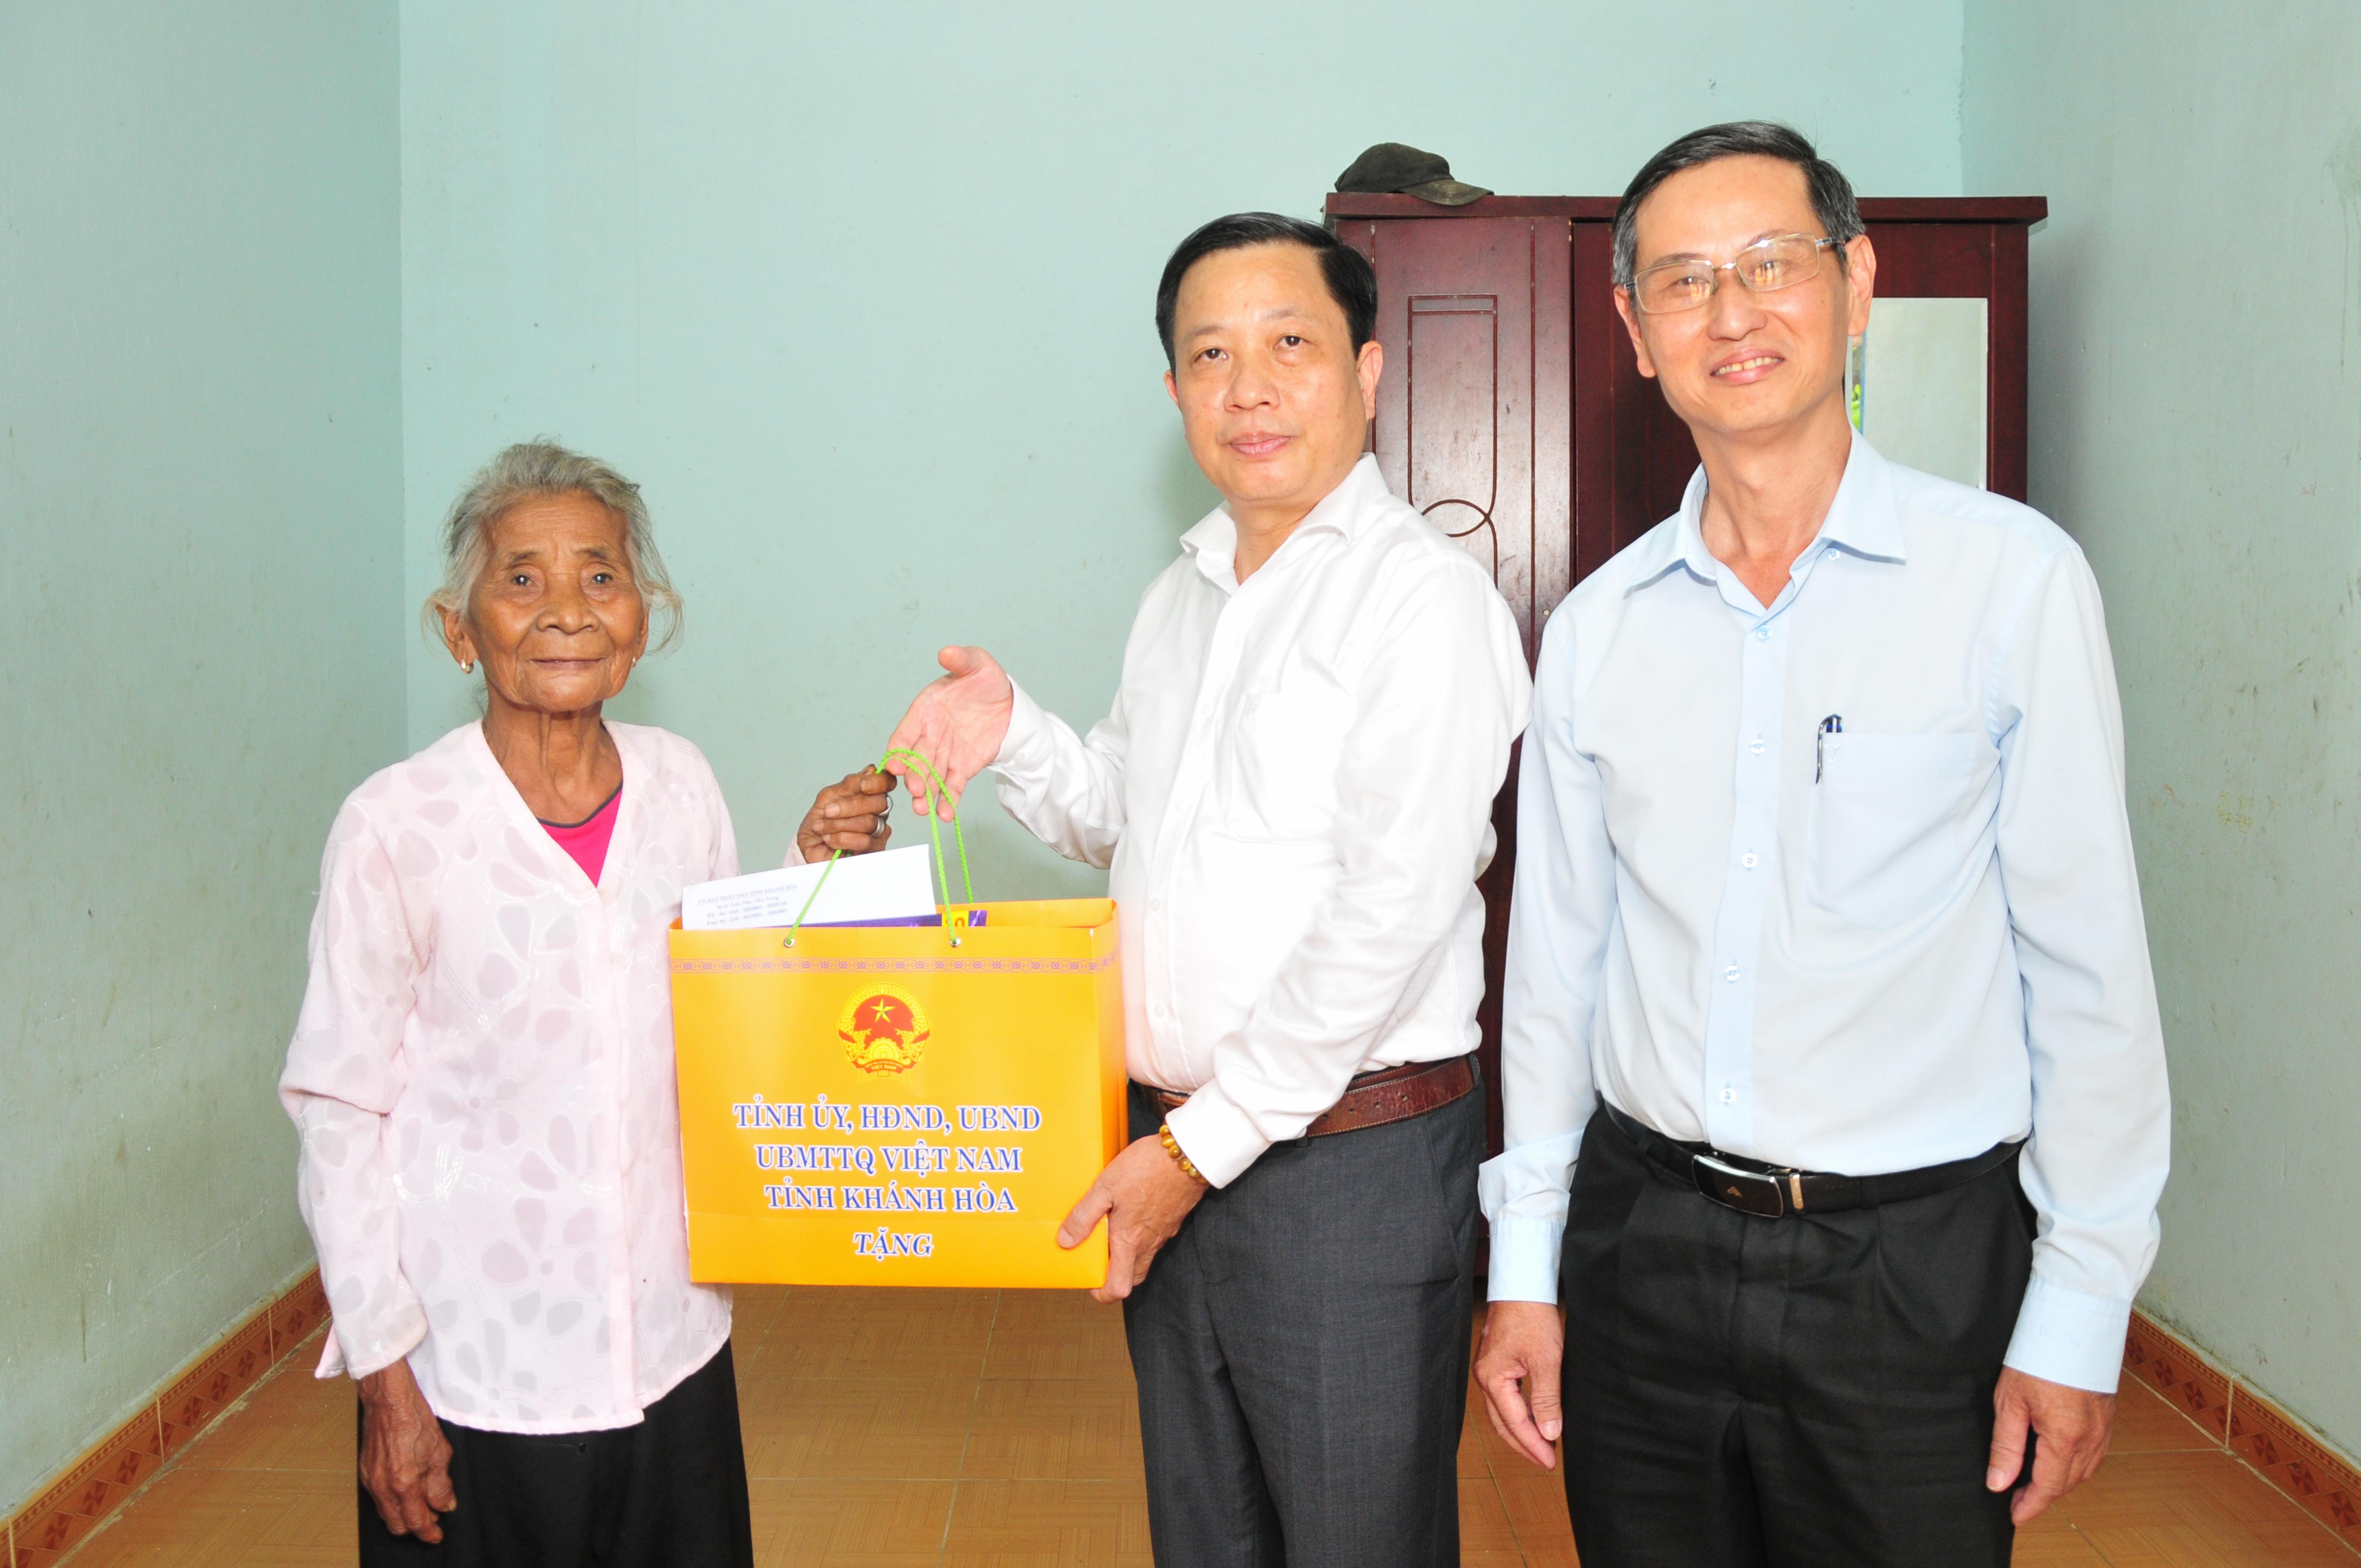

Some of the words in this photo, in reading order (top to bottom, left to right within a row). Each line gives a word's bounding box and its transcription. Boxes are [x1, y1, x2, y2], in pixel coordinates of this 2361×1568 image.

[733, 1095, 803, 1127] TỈNH
[812, 1094, 853, 1133] ỦY,
[859, 1105, 951, 1134] HĐND,
[957, 1106, 1041, 1130] UBND
[755, 1145, 875, 1174] UBMTTQ
[880, 1140, 949, 1176] VIỆT
[956, 1147, 1022, 1171] NAM
[765, 1177, 834, 1209] TỈNH
[842, 1181, 945, 1210] KHÁNH
[953, 1182, 1017, 1211] HÒA
[854, 1228, 932, 1260] TẶNG
